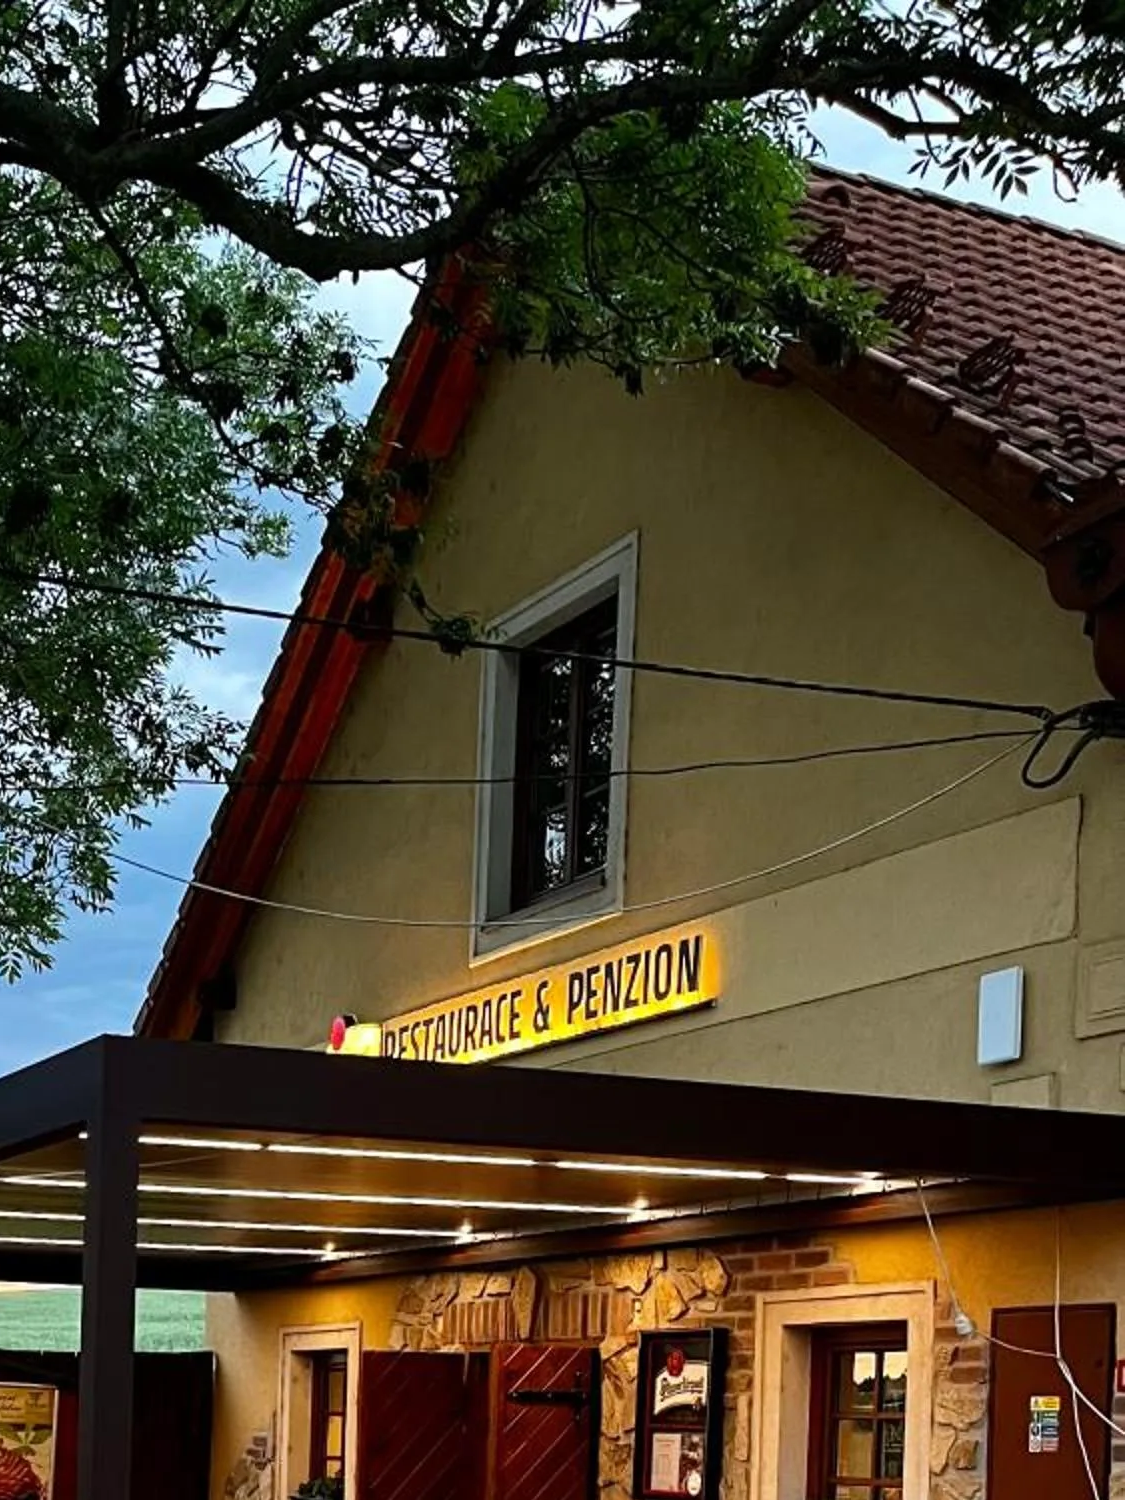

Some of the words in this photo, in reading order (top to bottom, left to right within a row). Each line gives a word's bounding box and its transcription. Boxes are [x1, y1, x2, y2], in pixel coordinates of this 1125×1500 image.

[384, 989, 523, 1061] RESTAURACE
[532, 979, 551, 1034] &
[567, 934, 704, 1025] PENZION
